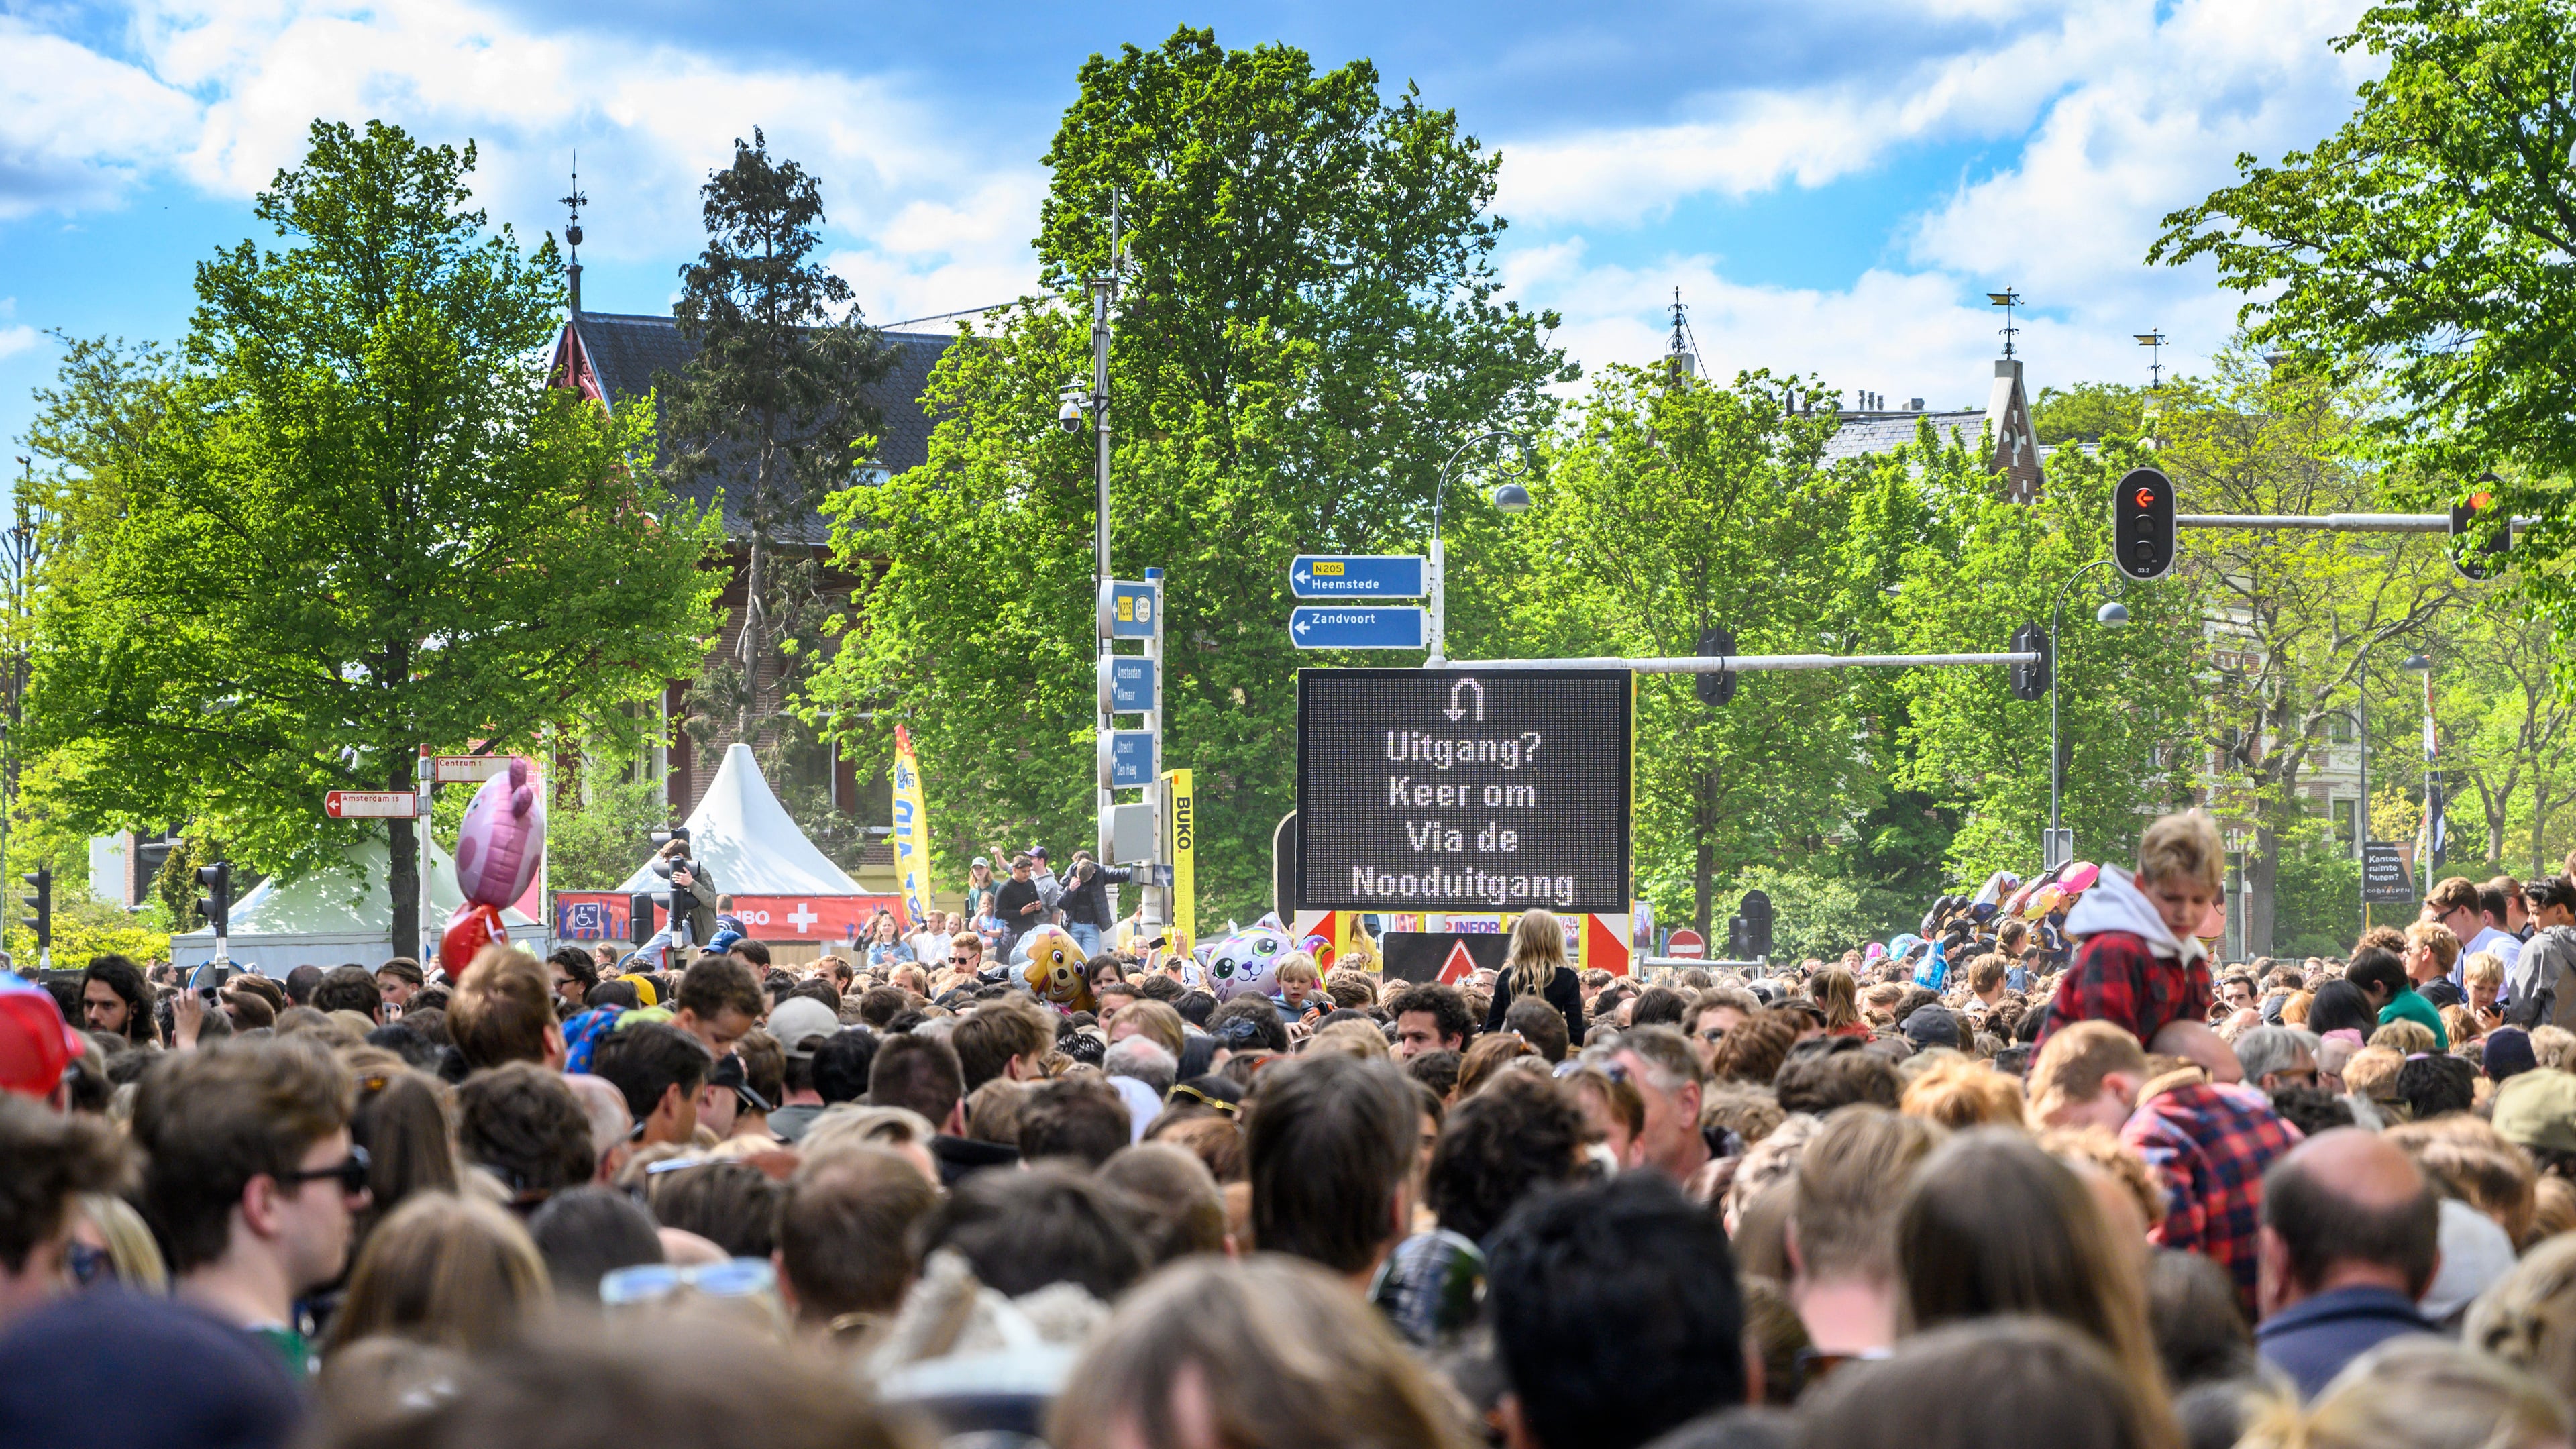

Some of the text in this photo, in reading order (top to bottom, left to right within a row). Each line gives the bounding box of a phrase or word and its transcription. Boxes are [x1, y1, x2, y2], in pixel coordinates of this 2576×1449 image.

[1312, 580, 1379, 589] Heemstede
[1119, 602, 1132, 616] N205
[1312, 614, 1375, 624] Zandvoort
[1118, 665, 1141, 679] Amsterdam
[1118, 688, 1135, 701] Alkmaar
[1117, 741, 1133, 753] Utrecht
[1388, 731, 1541, 769] Uitgang?
[1117, 763, 1137, 779] Den Haag
[1390, 777, 1535, 806] Keer om
[1406, 822, 1517, 851] Via de
[2369, 855, 2406, 863] Kantoor-
[2369, 864, 2398, 872] ruimte
[2369, 873, 2400, 881] huren?
[1177, 857, 1187, 927] INFRASUPPORT
[1352, 867, 1573, 906] Nooduitgang
[1454, 922, 1501, 934] INFOR
